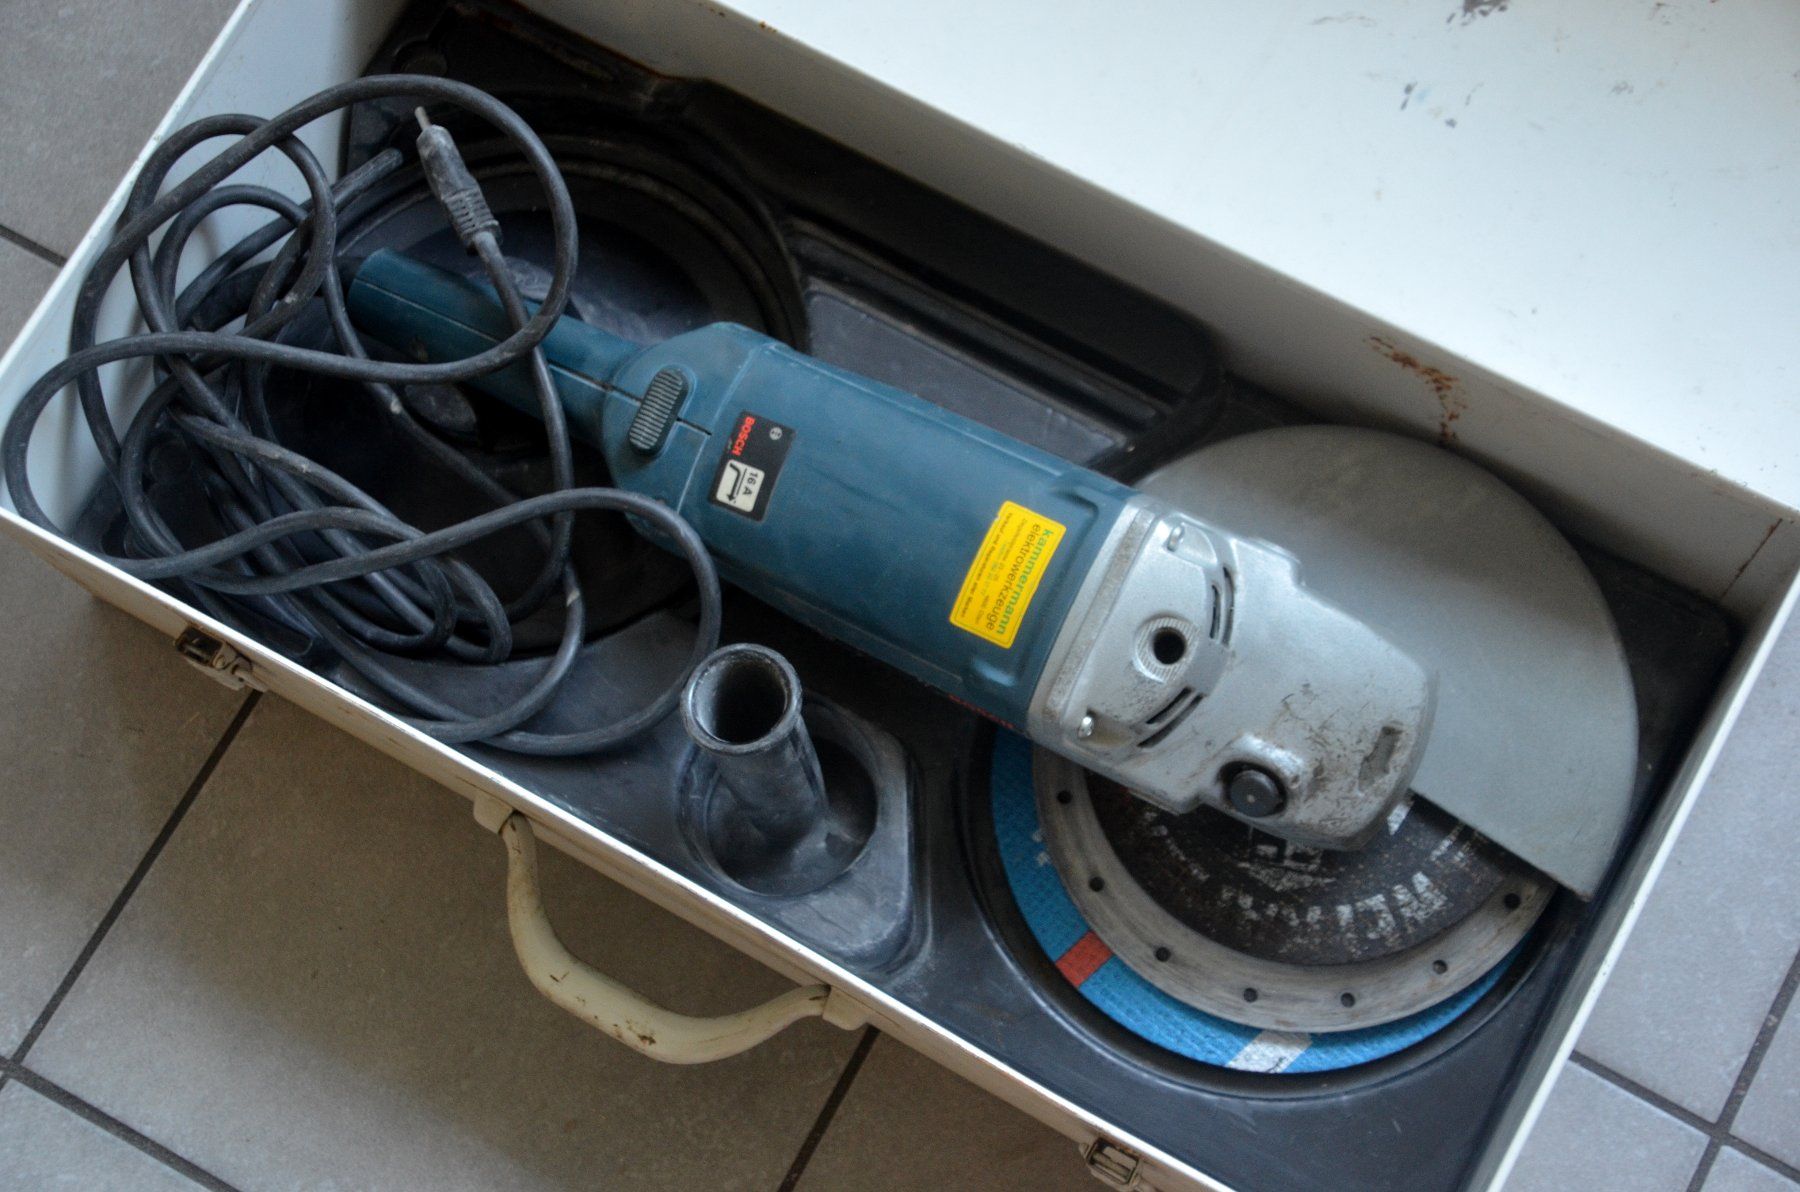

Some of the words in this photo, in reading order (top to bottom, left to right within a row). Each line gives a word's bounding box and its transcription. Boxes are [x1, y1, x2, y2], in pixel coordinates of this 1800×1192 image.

[732, 416, 756, 456] BOSCH
[742, 486, 753, 496] A
[747, 472, 758, 485] 16
[985, 524, 1040, 631] elektrowerkzeuge
[996, 528, 1054, 635] kammermann
